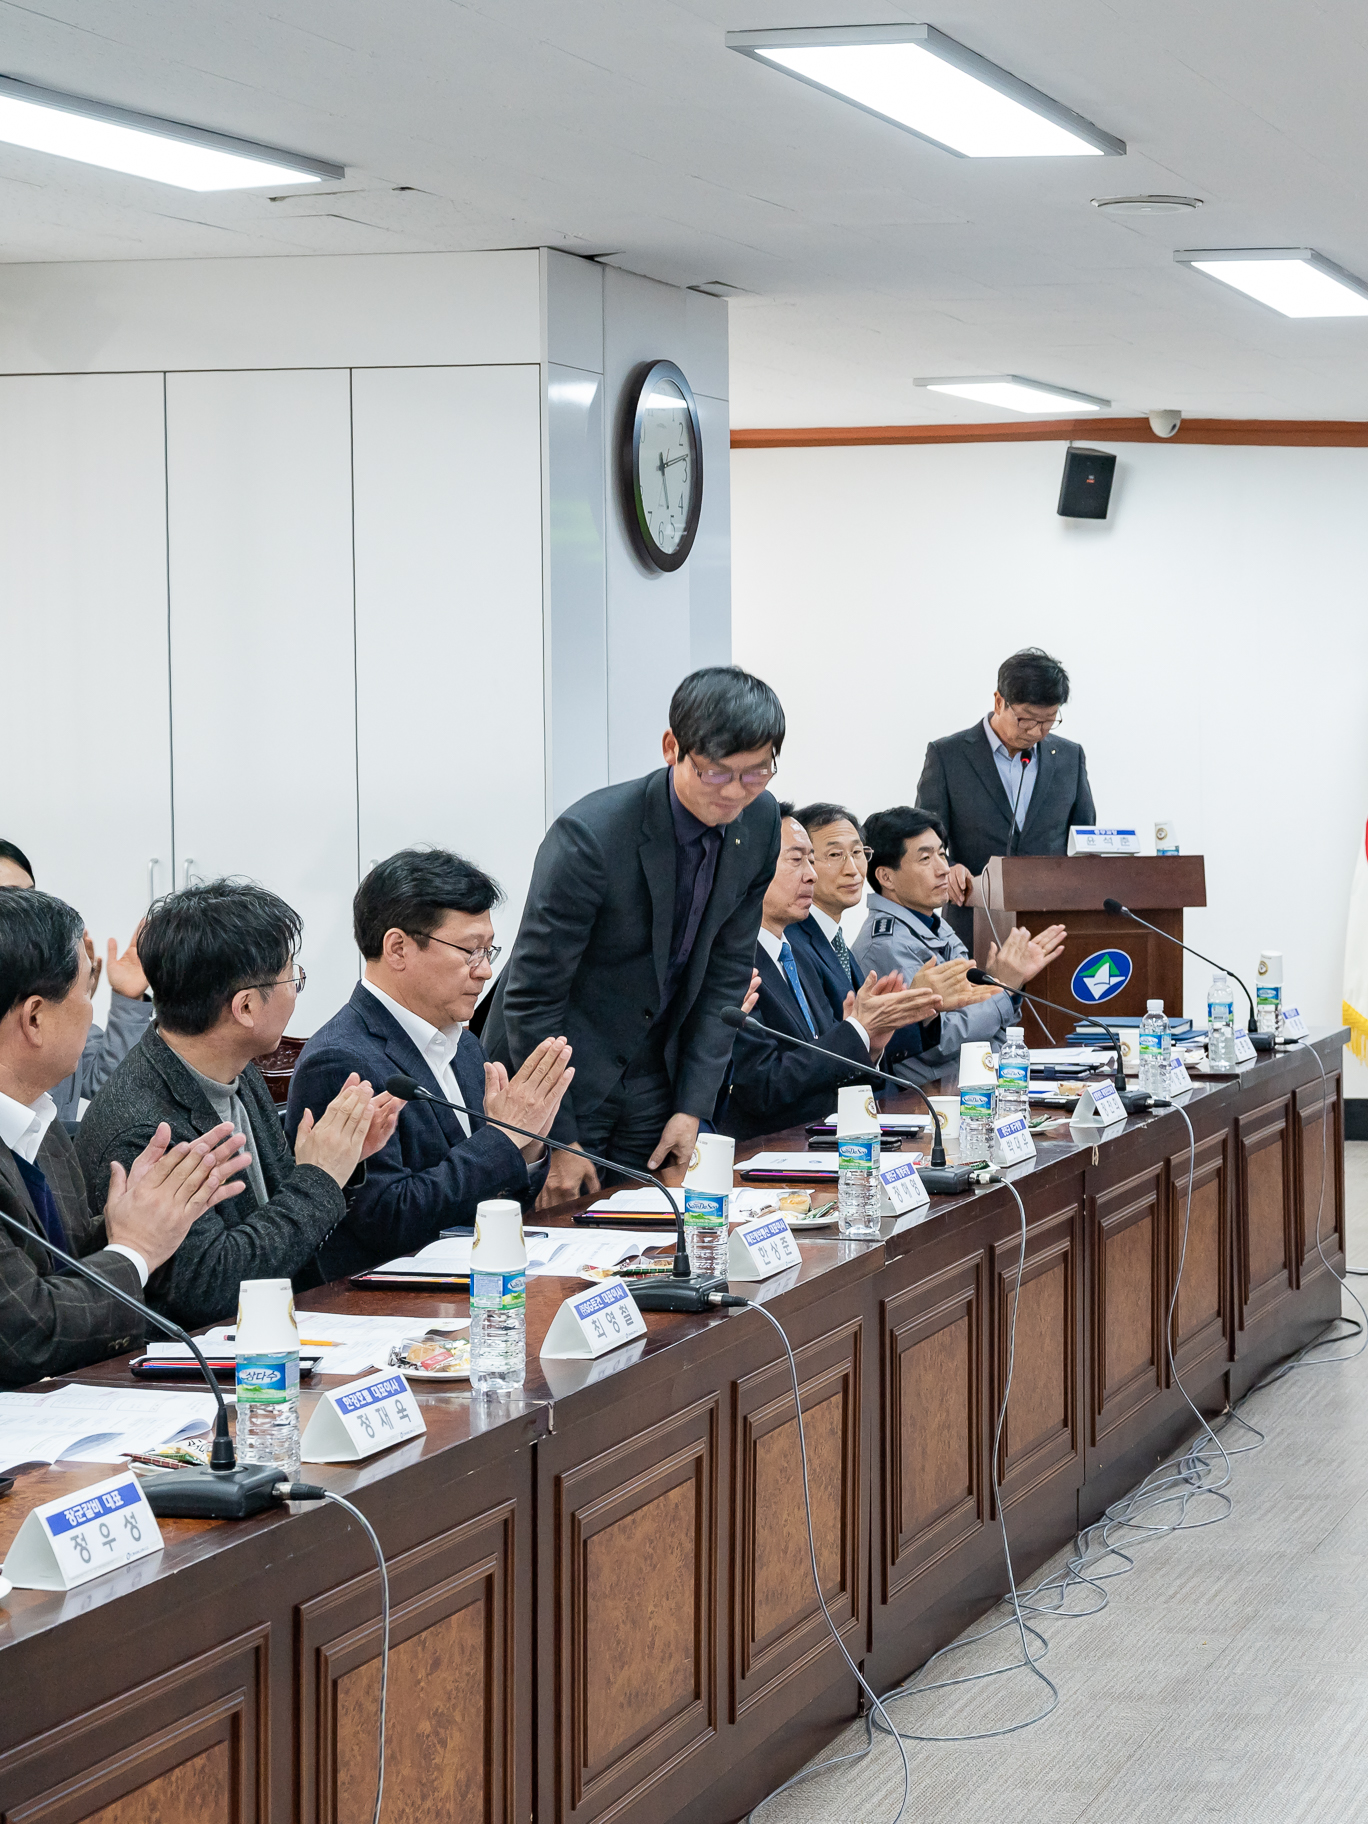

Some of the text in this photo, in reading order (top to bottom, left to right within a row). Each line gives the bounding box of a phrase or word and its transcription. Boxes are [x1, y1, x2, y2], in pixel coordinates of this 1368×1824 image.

[679, 422, 684, 446] 2
[682, 457, 688, 483] 3
[678, 490, 684, 515] 4
[659, 521, 664, 545] 6
[758, 1236, 792, 1266] 한상준
[601, 1286, 625, 1303] 대표이사
[591, 1304, 634, 1339] 최영철
[342, 1379, 400, 1410] 한강호텔 대표이사
[356, 1399, 411, 1439] 정재욱
[64, 1491, 124, 1526] 장군갈비 대표
[70, 1511, 141, 1564] 정우성
